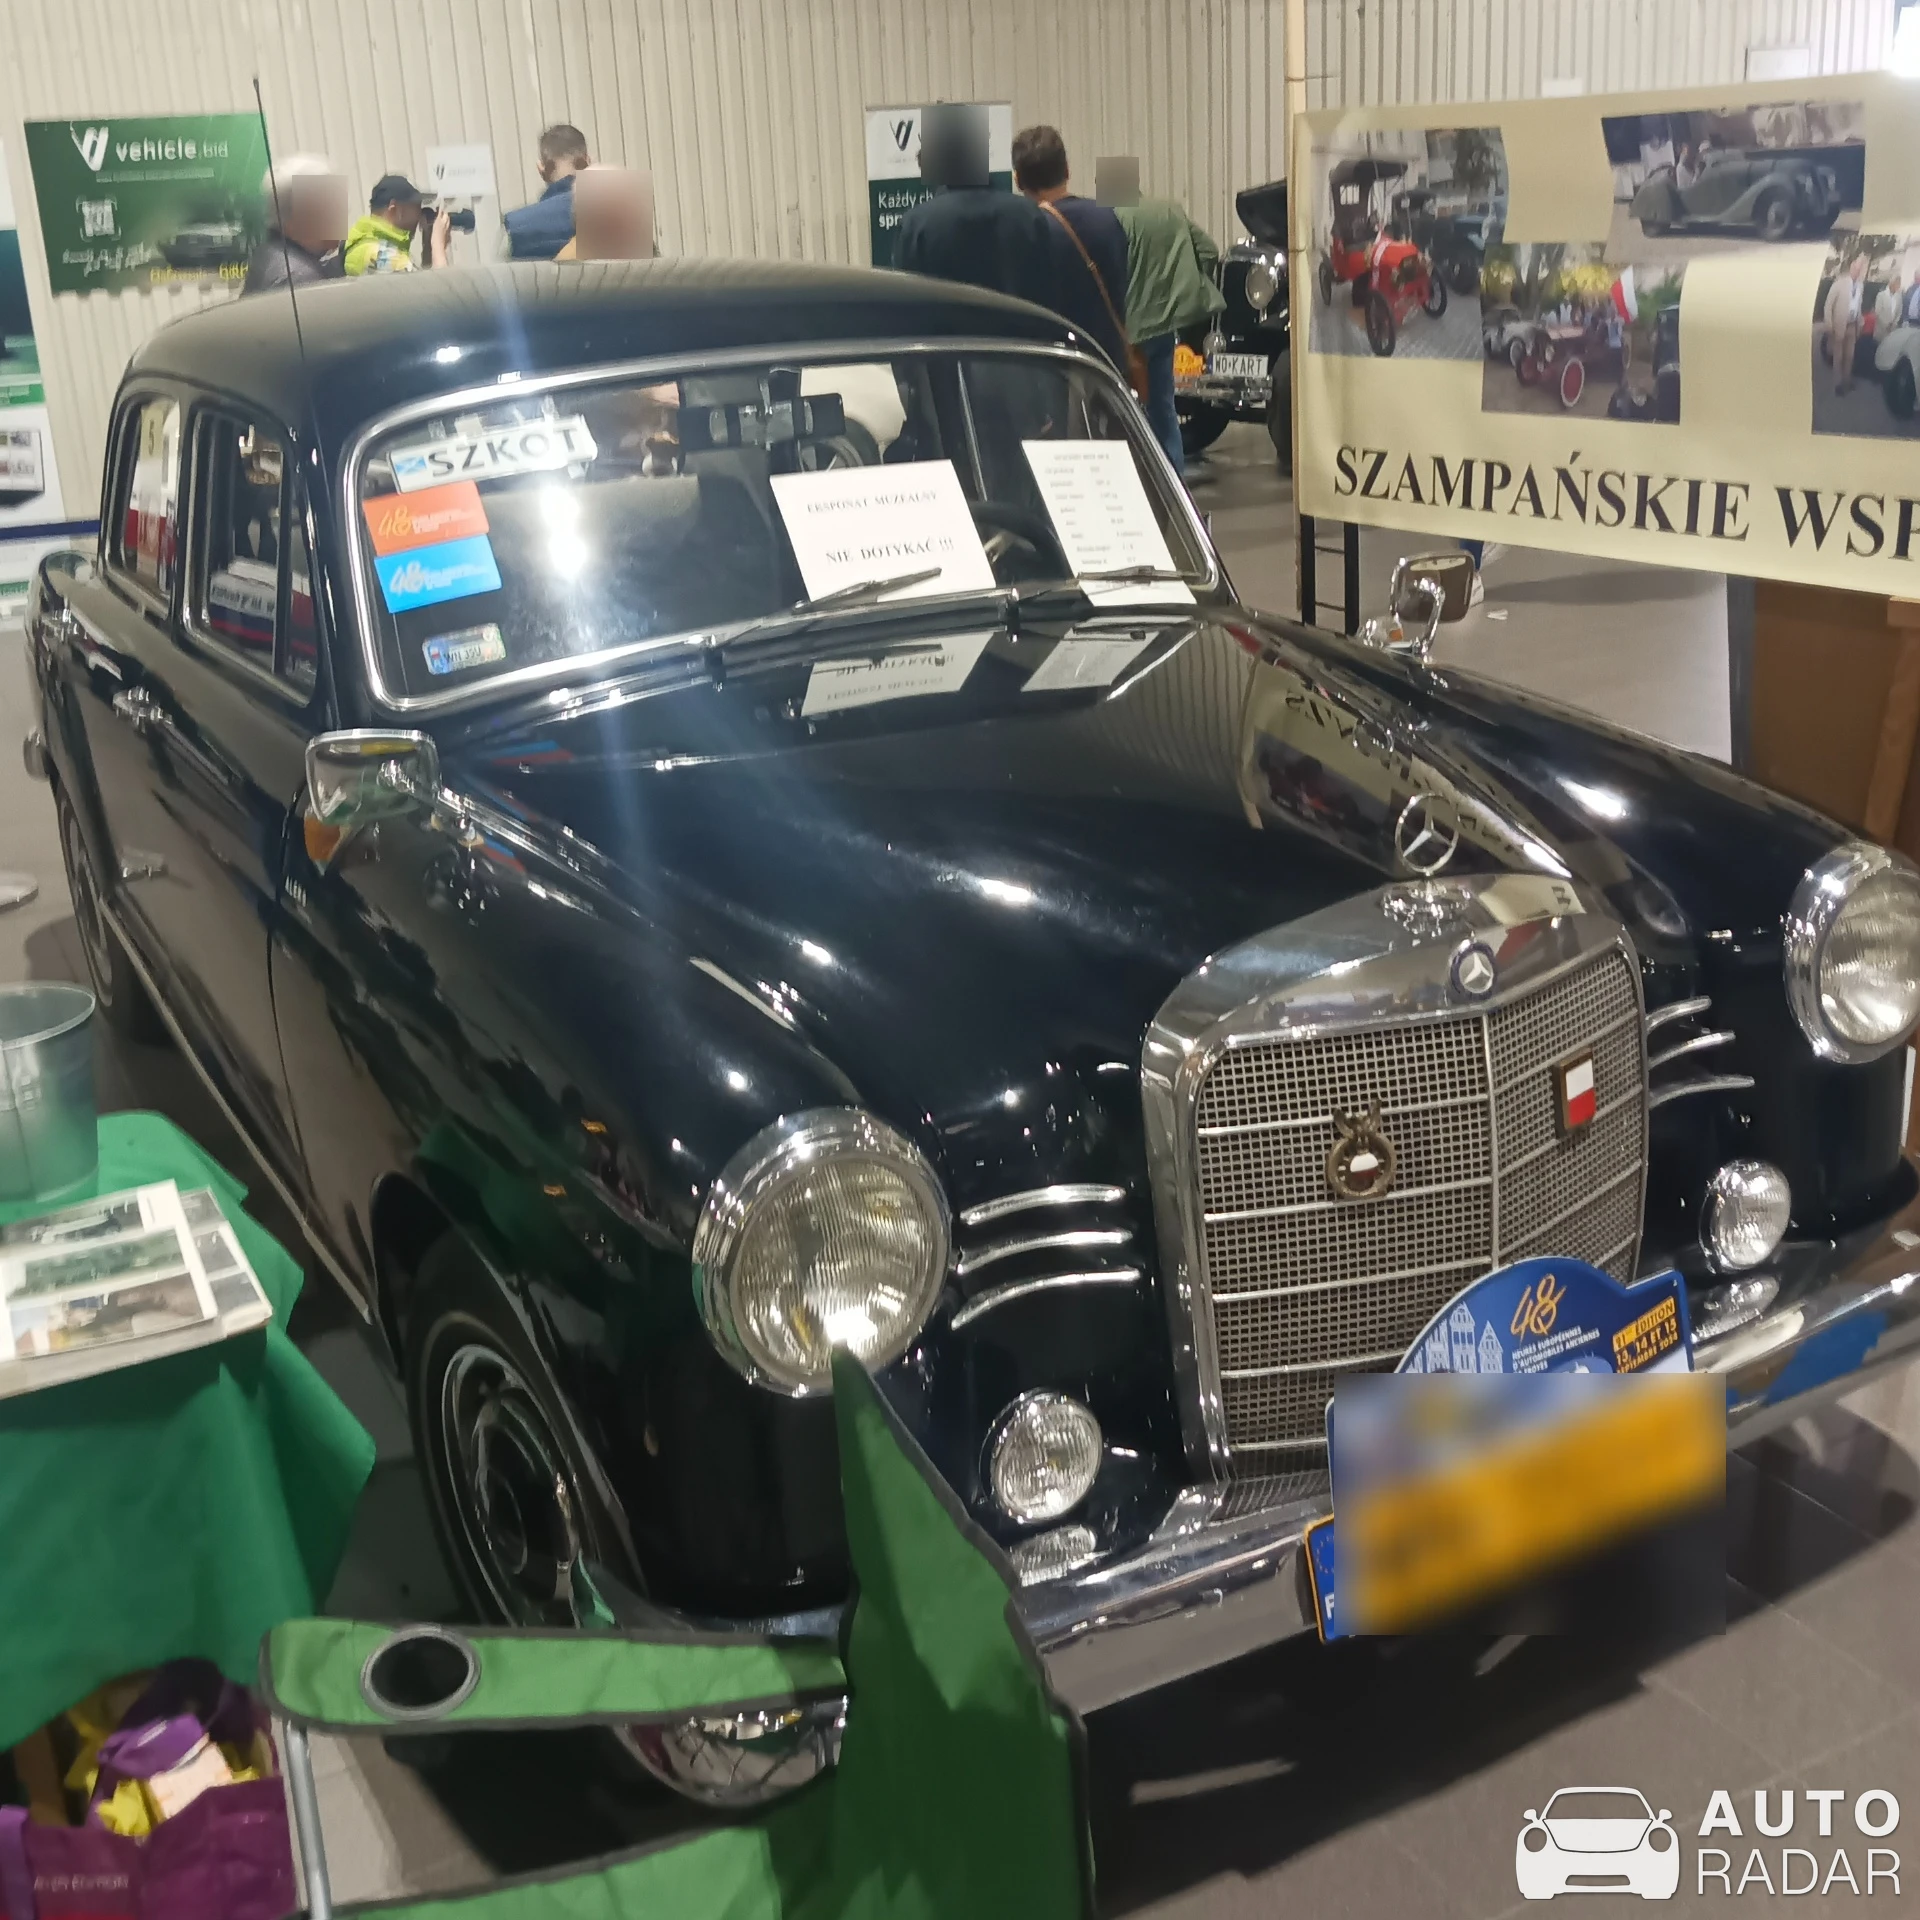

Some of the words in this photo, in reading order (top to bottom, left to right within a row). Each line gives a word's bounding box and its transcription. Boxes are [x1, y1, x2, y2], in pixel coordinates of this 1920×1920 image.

[878, 190, 917, 209] Każdy
[428, 428, 578, 477] SZKOT
[807, 497, 869, 513] EKSPONAT
[874, 489, 937, 505] MUZEALNY
[1333, 444, 1750, 542] SZAMPAŃSKIE
[1774, 484, 1920, 561] WSP
[825, 548, 853, 565] NIE
[860, 536, 935, 561] DOTYKAĆ
[1511, 1272, 1568, 1342] 48
[1565, 1328, 1601, 1351] ANCIENNES
[1650, 1327, 1661, 1344] ET
[1512, 1342, 1537, 1360] HEURES
